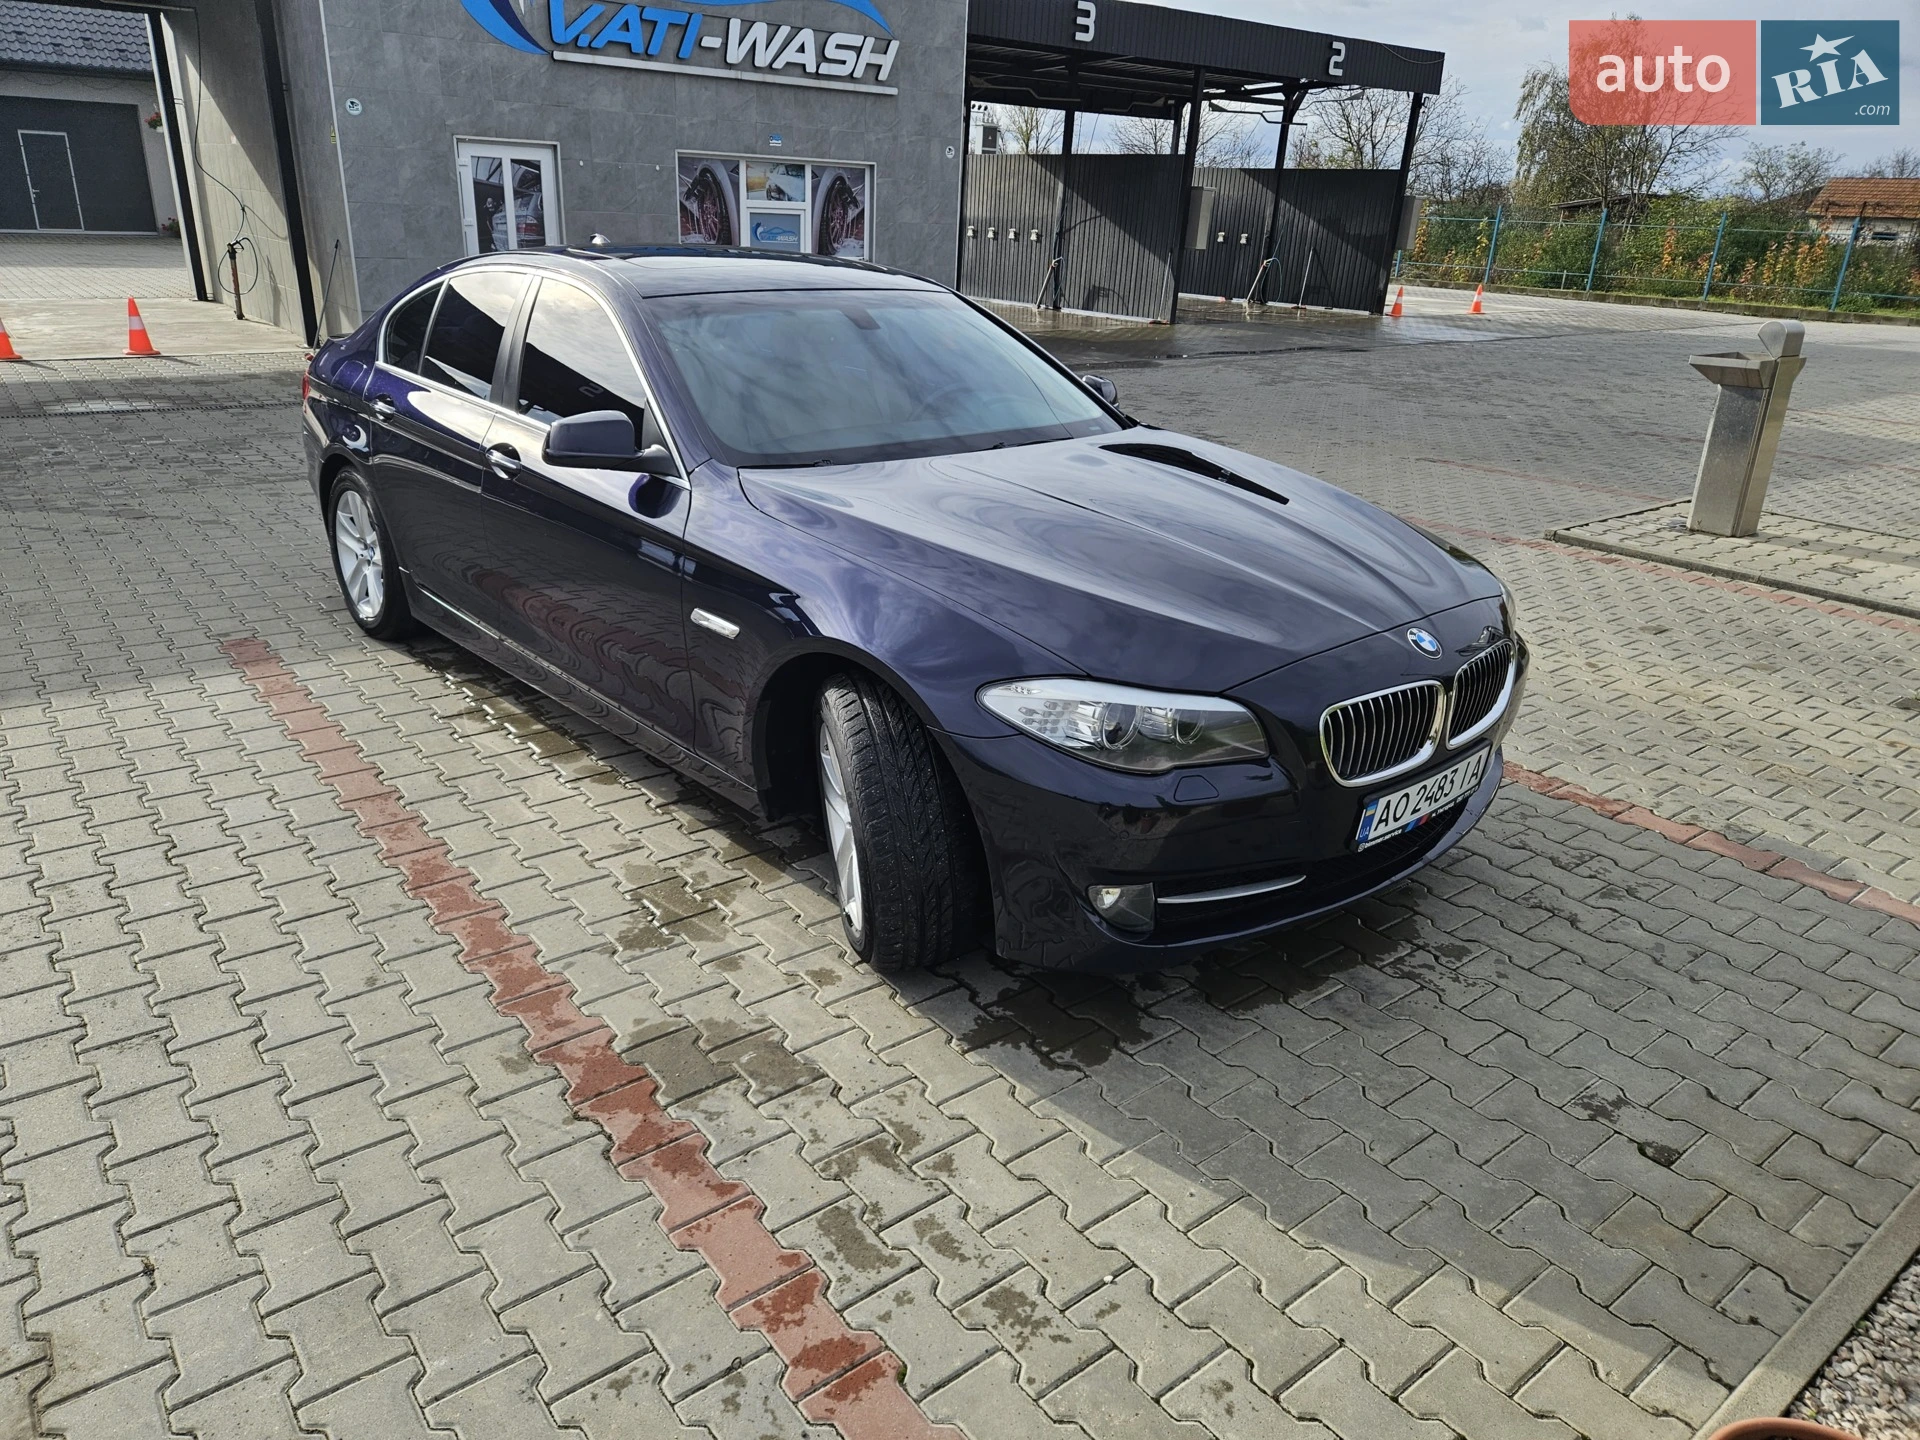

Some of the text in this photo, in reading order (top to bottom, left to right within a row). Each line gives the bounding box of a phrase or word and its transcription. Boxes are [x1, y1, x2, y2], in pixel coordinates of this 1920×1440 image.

[1075, 1, 1096, 42] 3
[1329, 41, 1346, 76] 2
[1373, 792, 1410, 832] AO
[1411, 767, 1459, 816] 2483
[1459, 754, 1482, 791] IA
